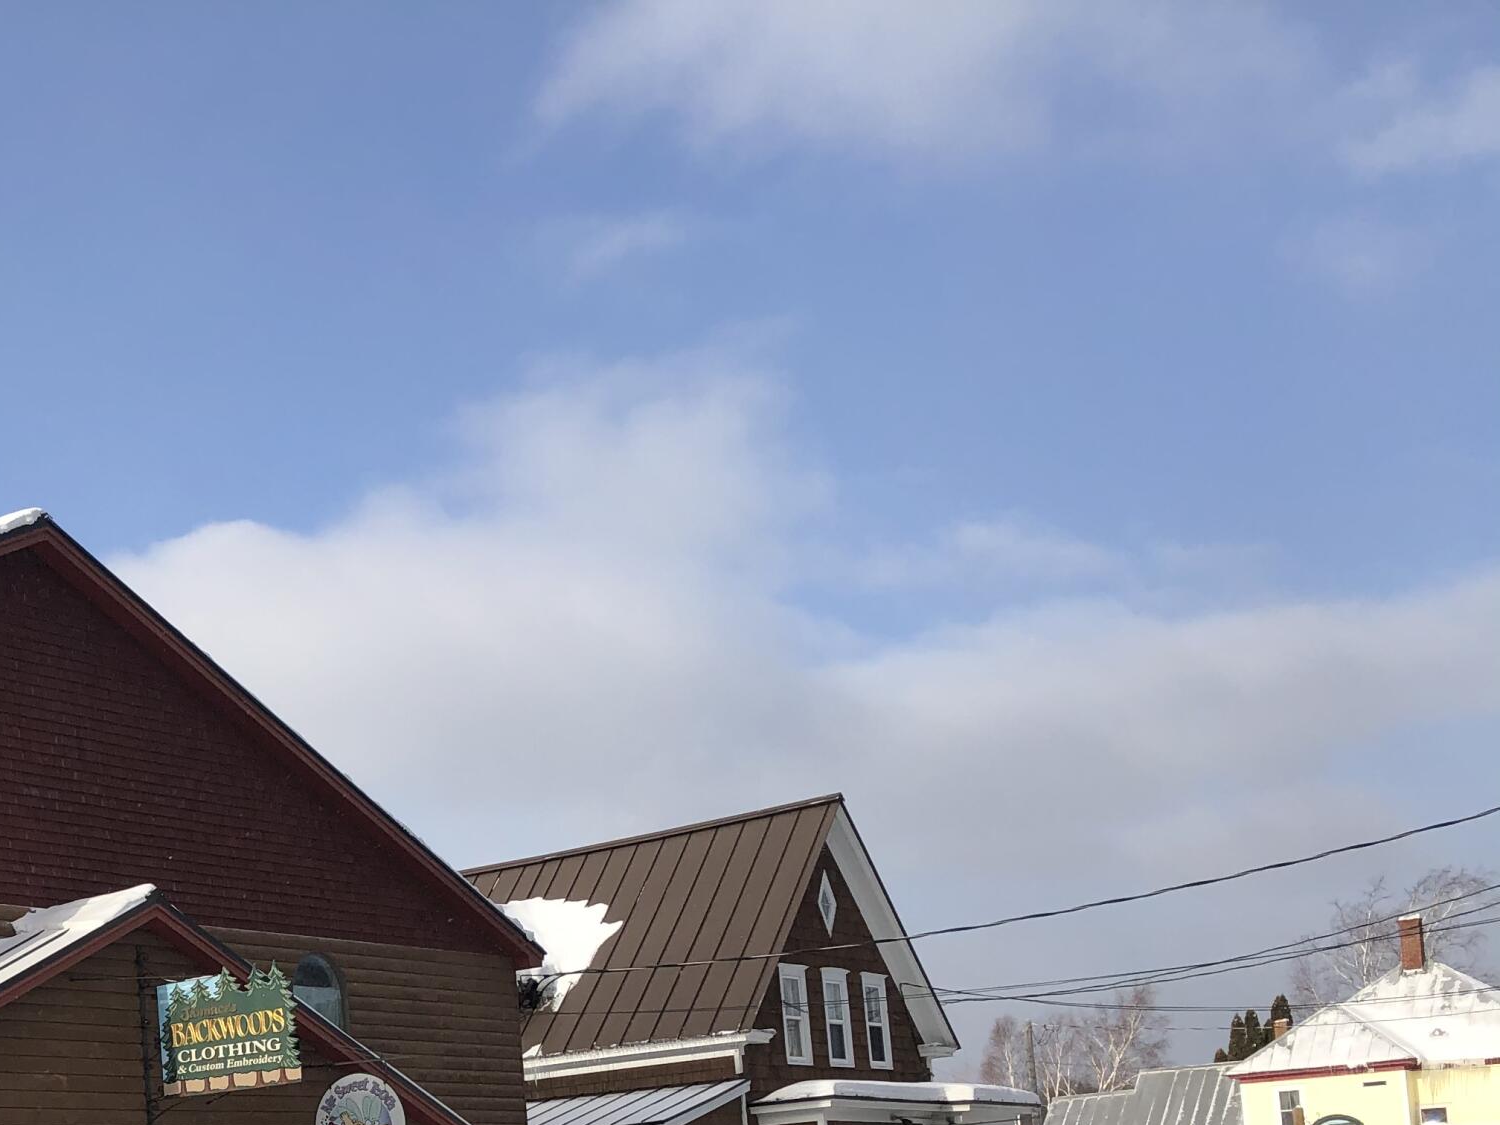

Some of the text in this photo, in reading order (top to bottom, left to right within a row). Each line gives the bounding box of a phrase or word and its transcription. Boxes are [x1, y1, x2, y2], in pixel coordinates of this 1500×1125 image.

[171, 1008, 285, 1048] BACKWOODS
[177, 1037, 281, 1063] CLOTHING
[177, 1054, 284, 1075] & Custom Embroidery
[334, 1078, 369, 1100] Sweet
[370, 1081, 396, 1111] Tooth
